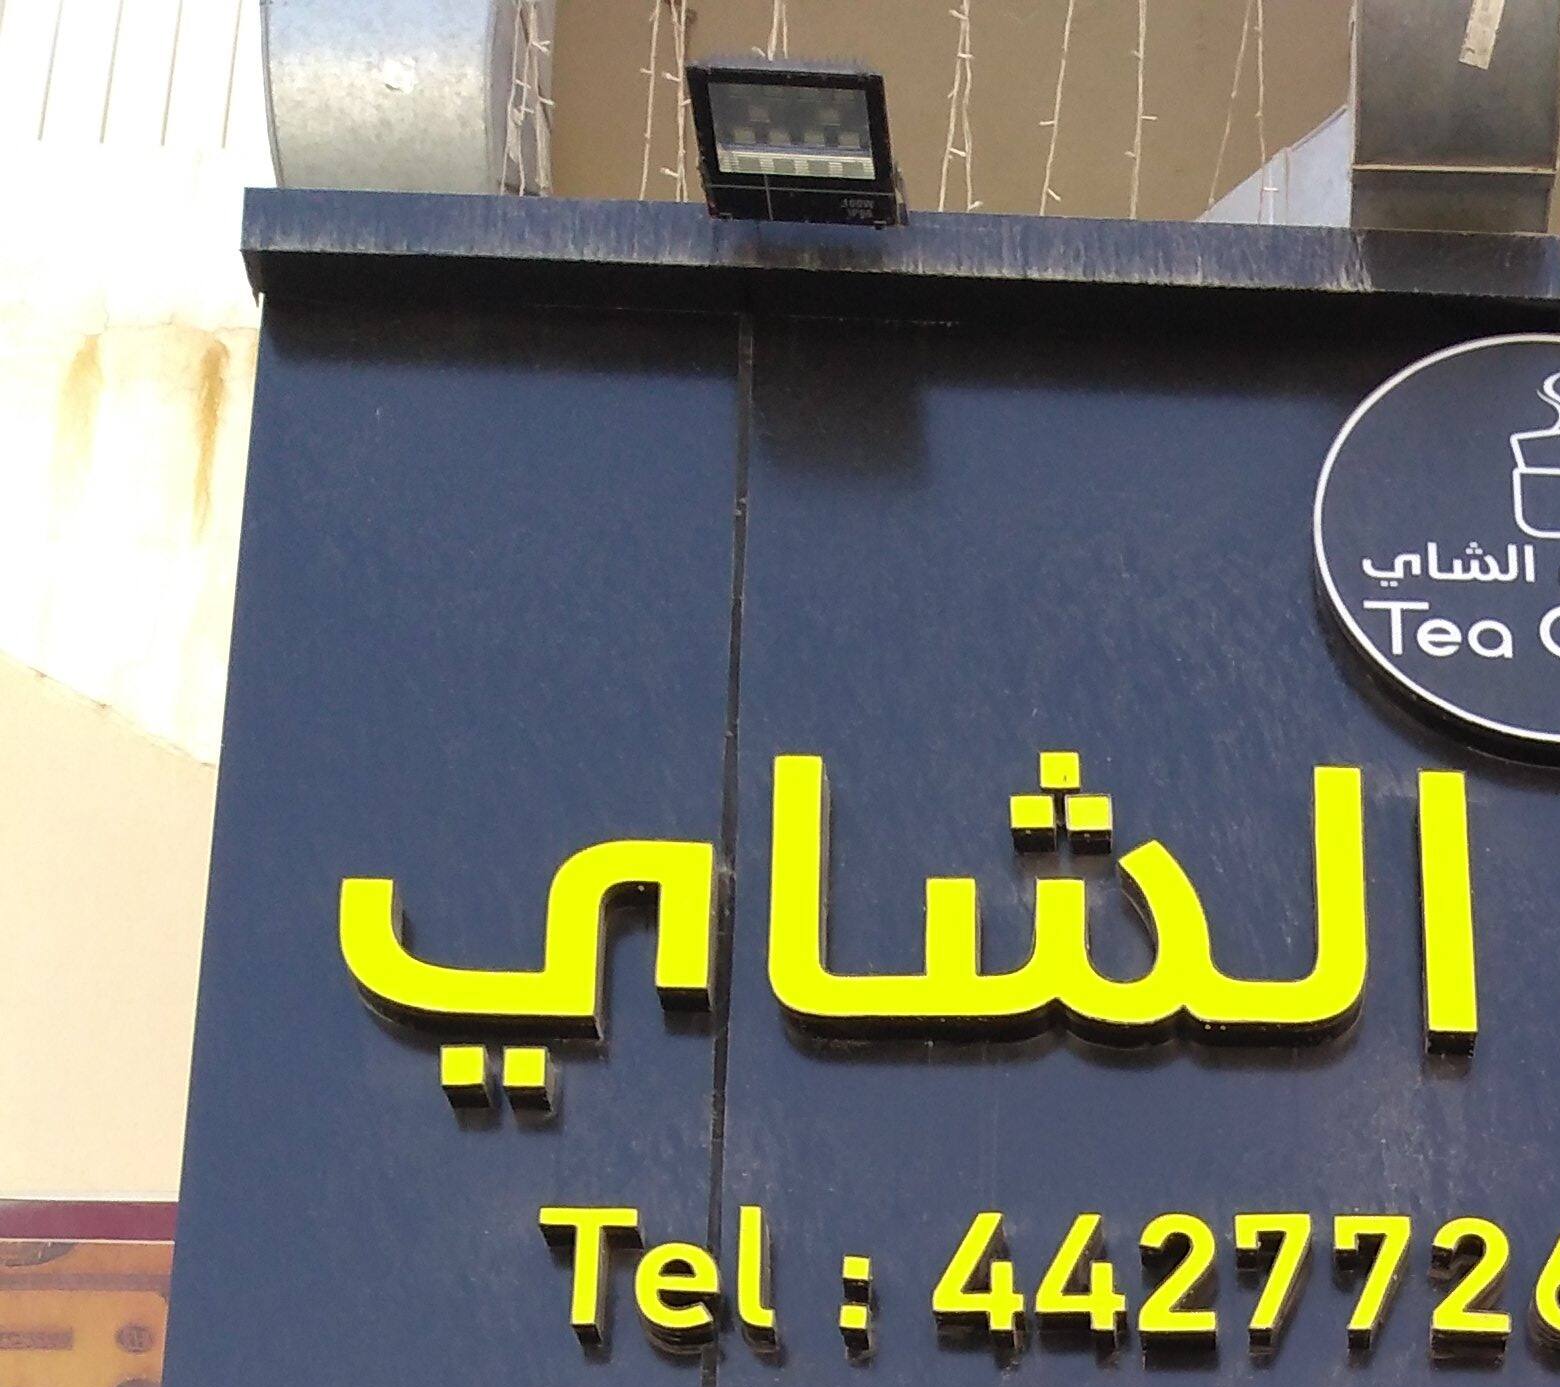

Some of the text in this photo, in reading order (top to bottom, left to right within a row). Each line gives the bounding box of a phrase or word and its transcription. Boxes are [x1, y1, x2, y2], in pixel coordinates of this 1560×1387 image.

[1361, 541, 1536, 588] الشاي
[1363, 599, 1514, 659] Tea
[340, 752, 1478, 1090] الشاي
[540, 1207, 772, 1330] Tel
